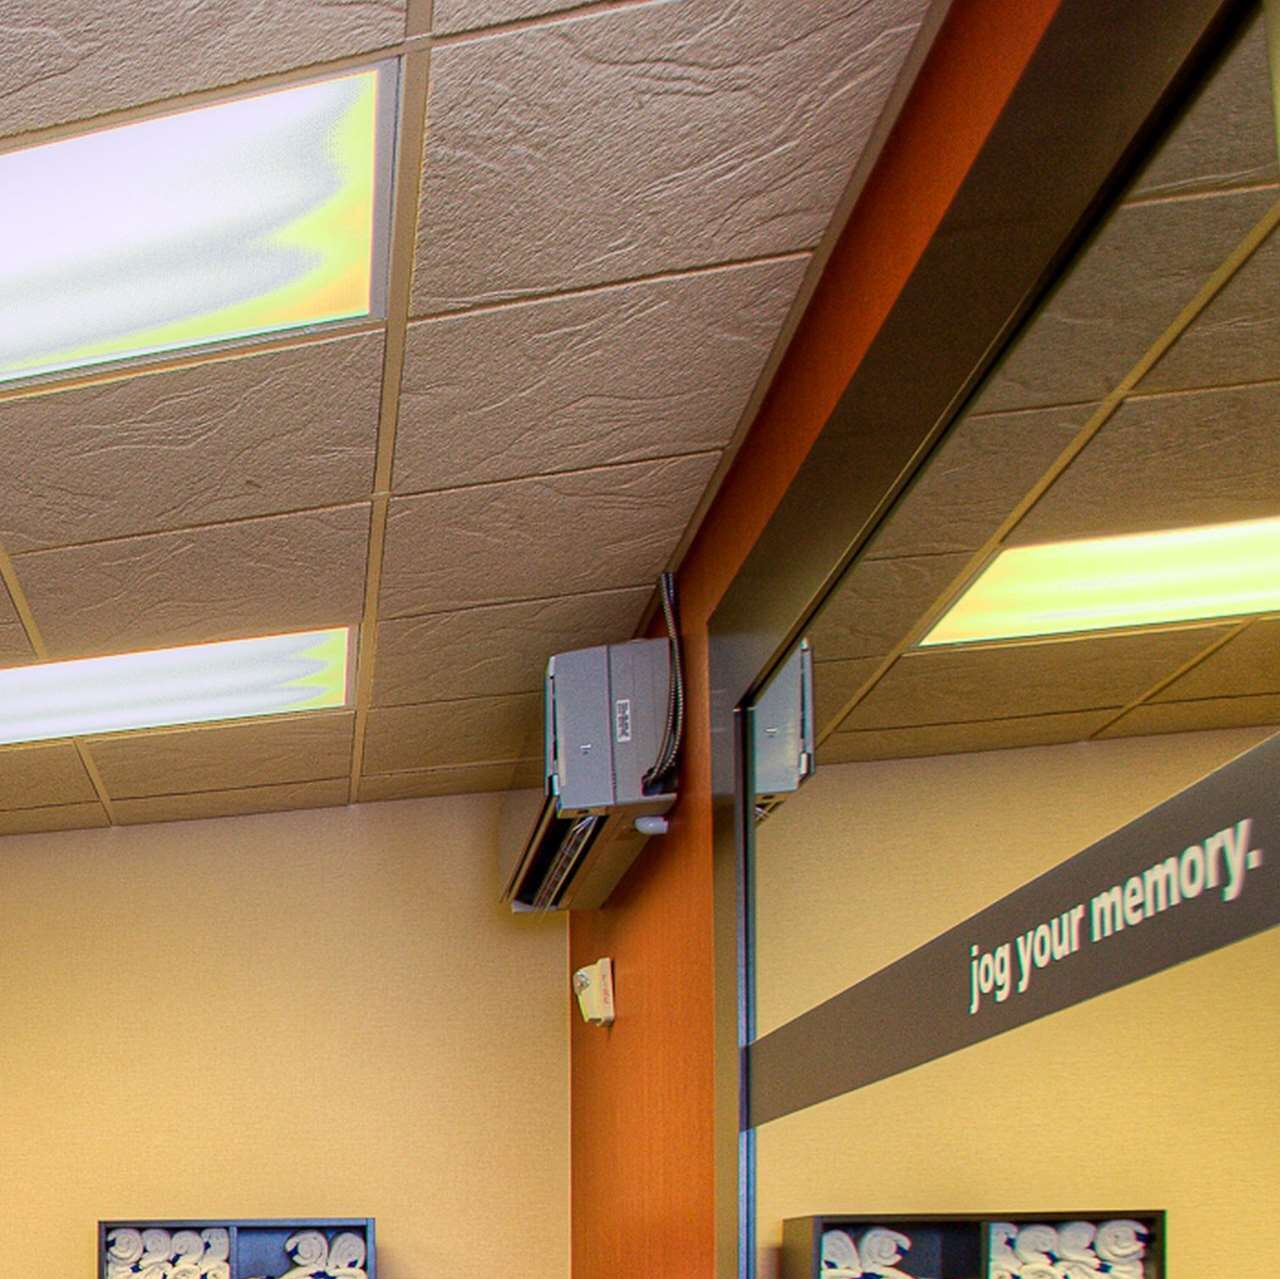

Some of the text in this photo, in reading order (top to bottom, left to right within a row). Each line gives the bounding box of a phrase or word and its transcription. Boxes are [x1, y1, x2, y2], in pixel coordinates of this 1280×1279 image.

[969, 818, 1263, 1015] jog your memory.
